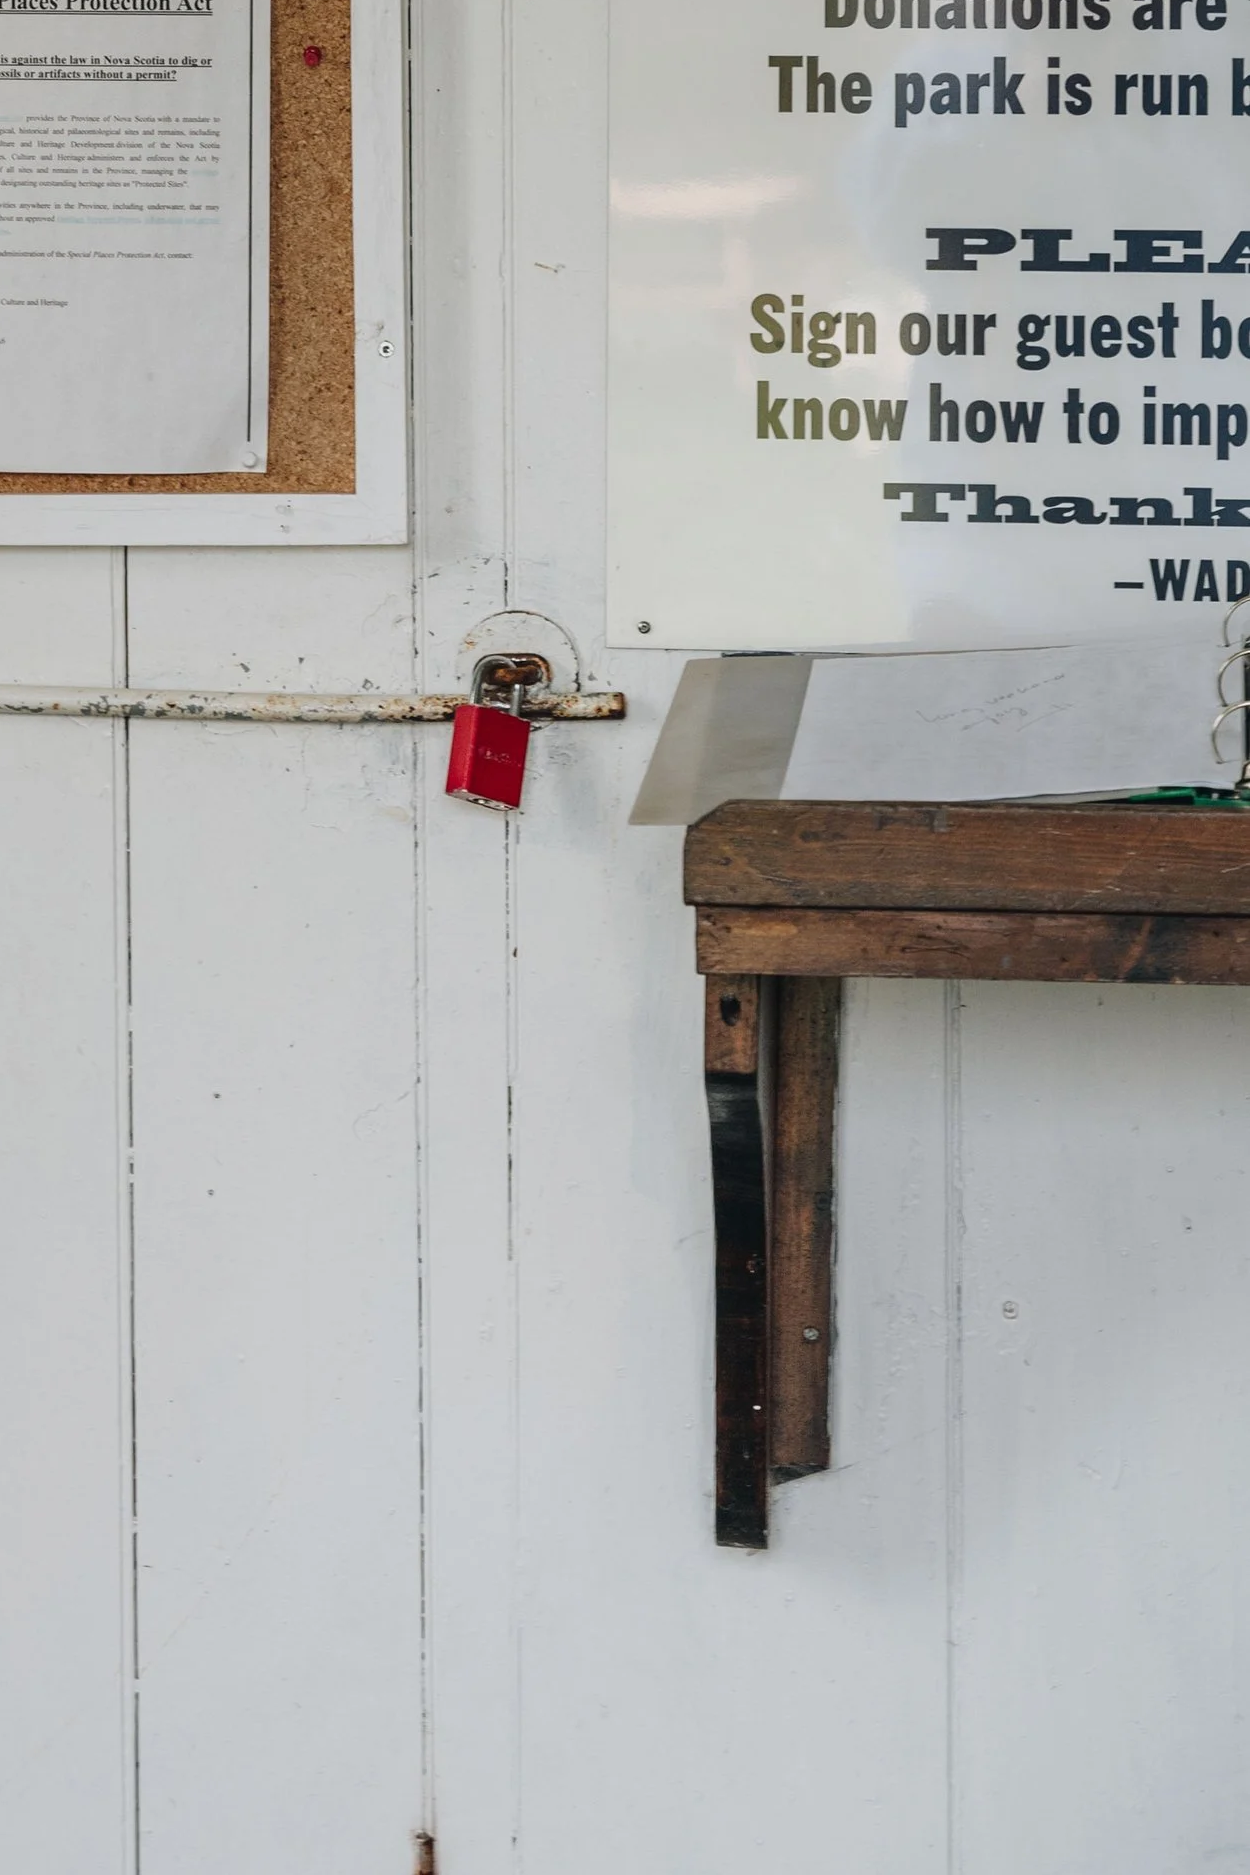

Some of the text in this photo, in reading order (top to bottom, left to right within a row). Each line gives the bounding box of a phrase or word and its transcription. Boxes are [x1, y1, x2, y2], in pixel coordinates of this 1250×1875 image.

[768, 55, 872, 115] The
[894, 58, 1025, 129] park
[1047, 58, 1094, 116] is
[1116, 74, 1209, 116] run
[750, 293, 878, 369] Sign
[899, 311, 997, 357] our
[1016, 301, 1180, 372] guest
[756, 380, 1248, 461] know how to imp
[883, 482, 1250, 527] Thank
